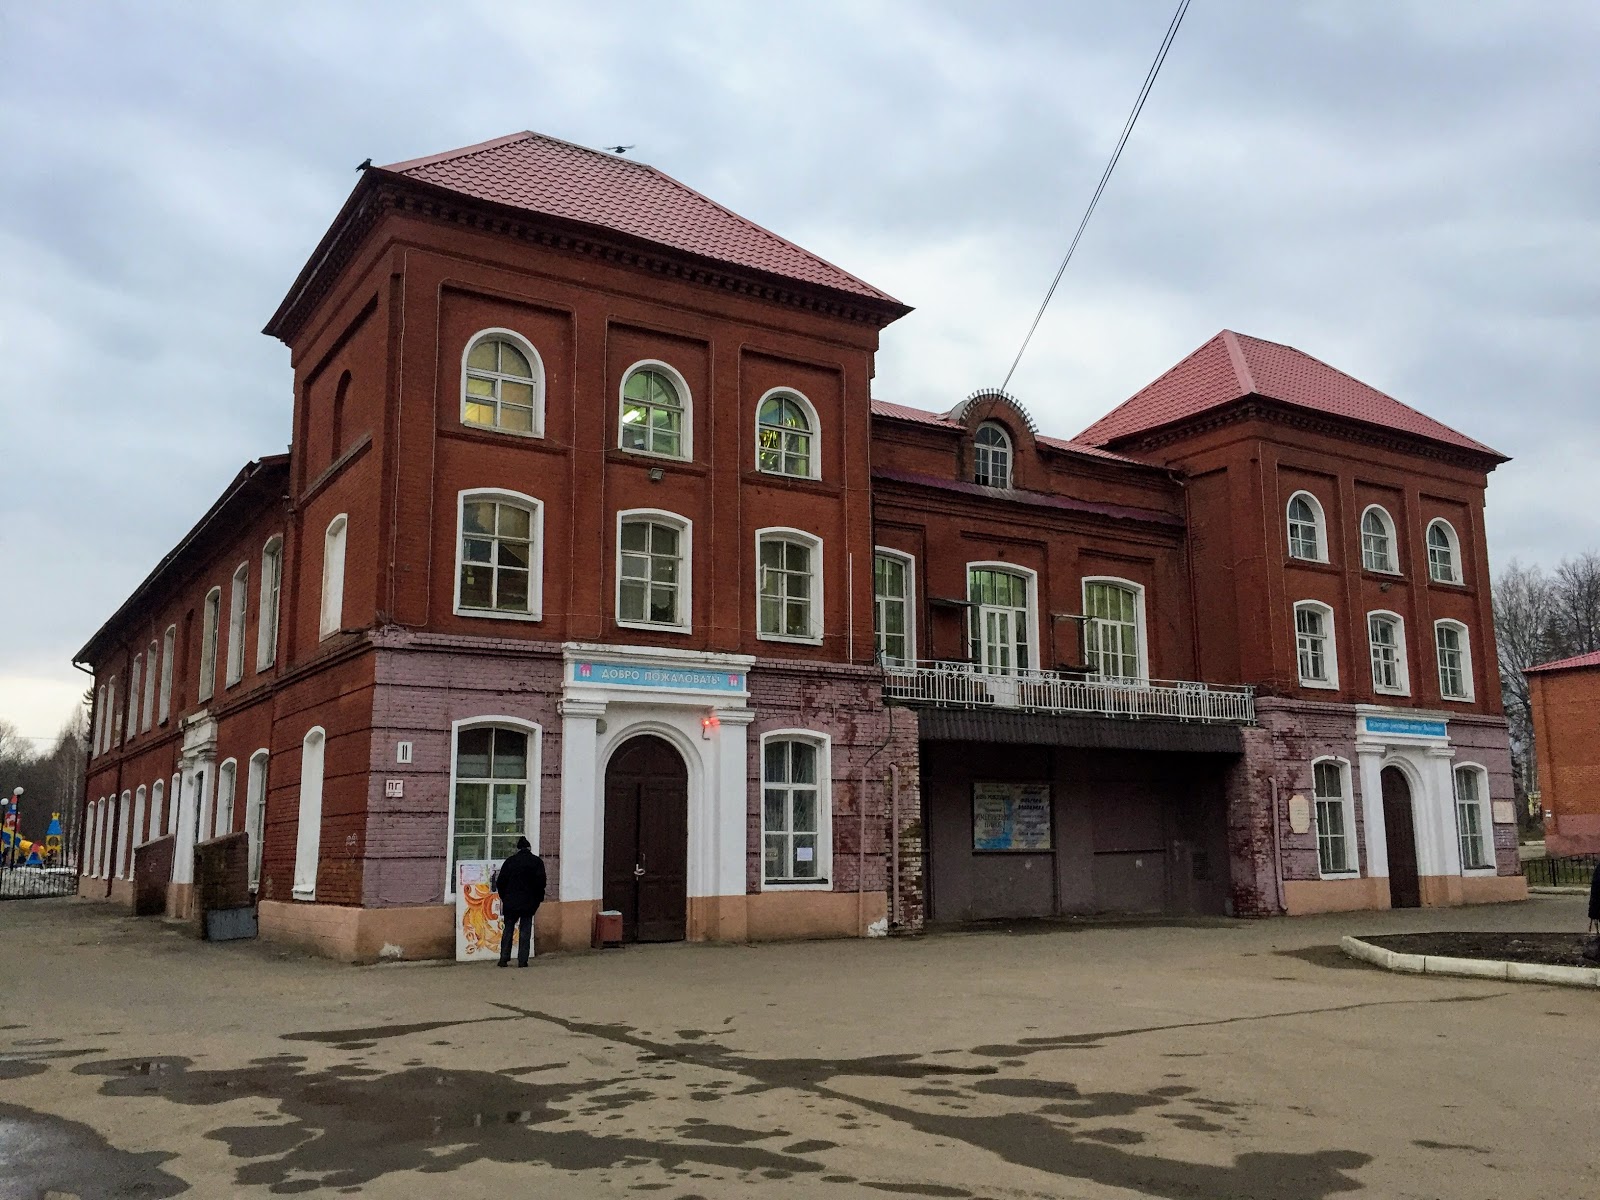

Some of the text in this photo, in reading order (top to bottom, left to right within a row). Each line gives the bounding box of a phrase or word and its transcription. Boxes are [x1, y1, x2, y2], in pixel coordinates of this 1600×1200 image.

[601, 669, 720, 684] ДОБРО ПОЖАЛОВАТЬ!
[388, 782, 401, 790] ПГ
